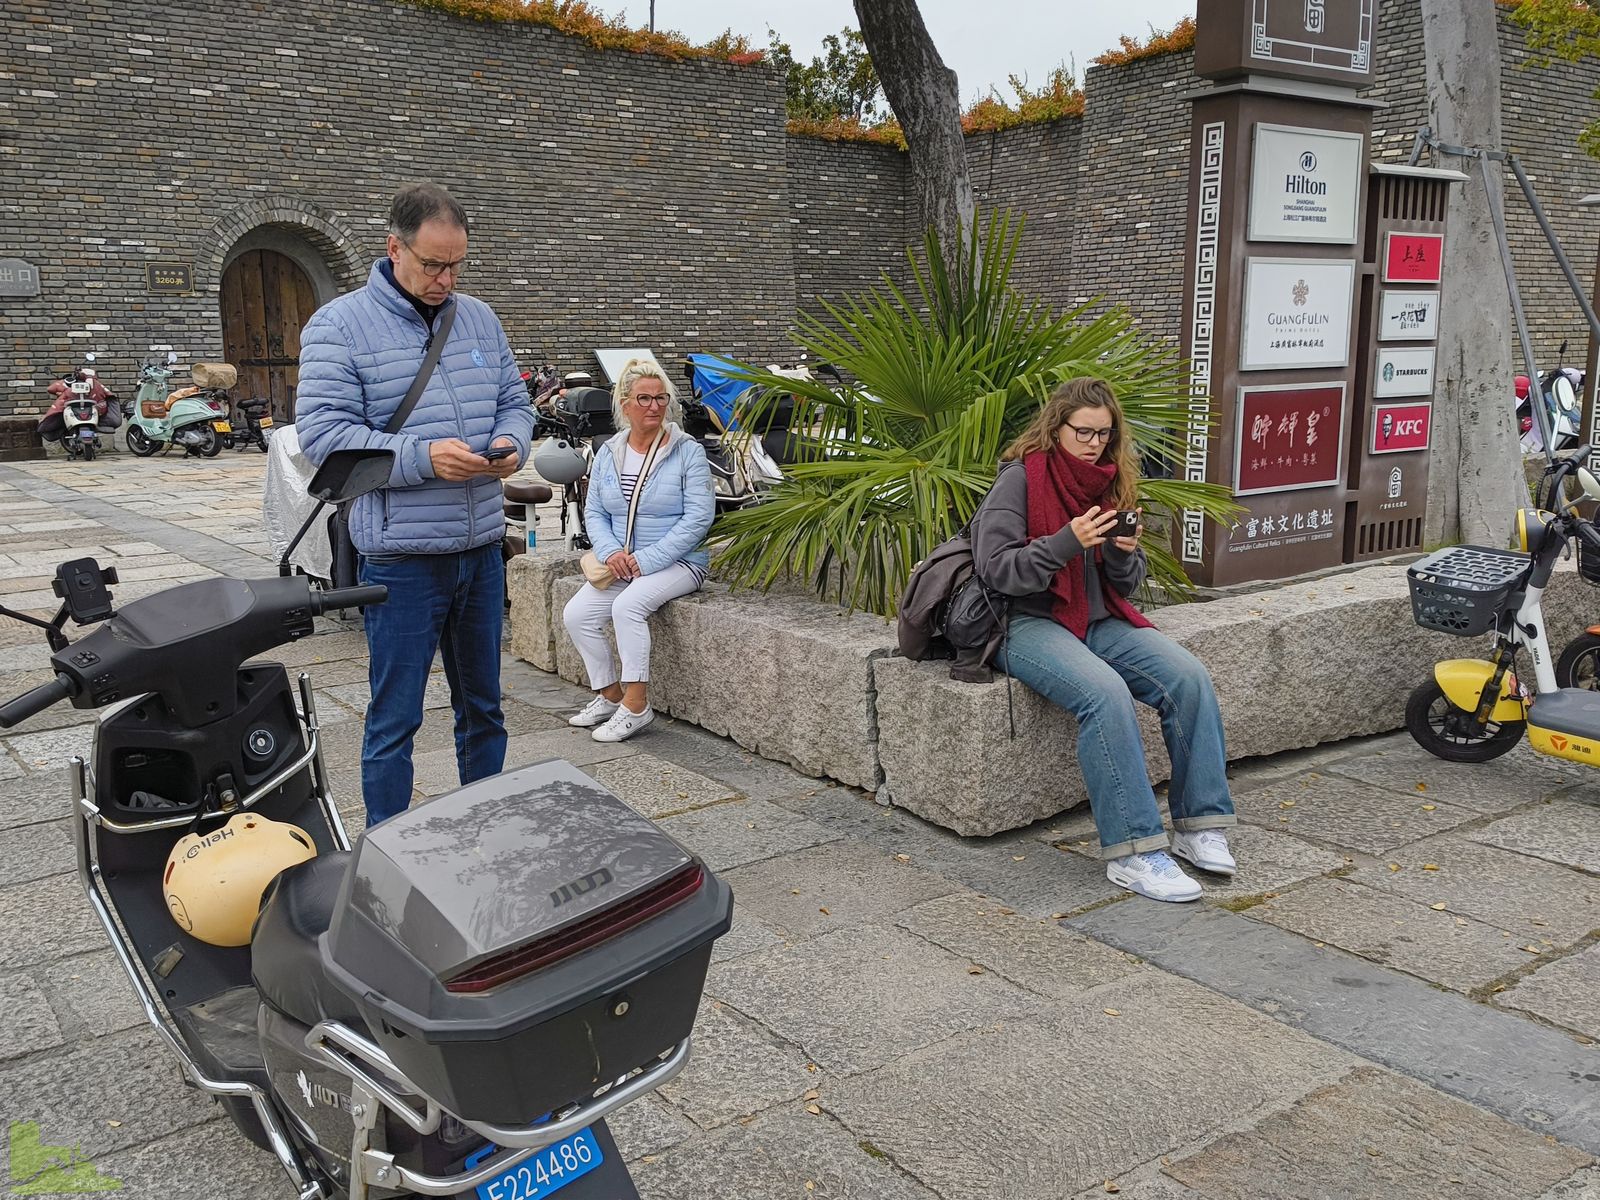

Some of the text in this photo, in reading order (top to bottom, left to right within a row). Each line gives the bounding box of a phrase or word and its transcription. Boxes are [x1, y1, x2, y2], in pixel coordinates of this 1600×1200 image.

[1286, 174, 1327, 195] Hilton
[1396, 368, 1428, 376] STARBUCKS
[1394, 419, 1423, 436] KFC
[1229, 542, 1253, 553] Guangfulin
[1252, 541, 1269, 550] Cultural
